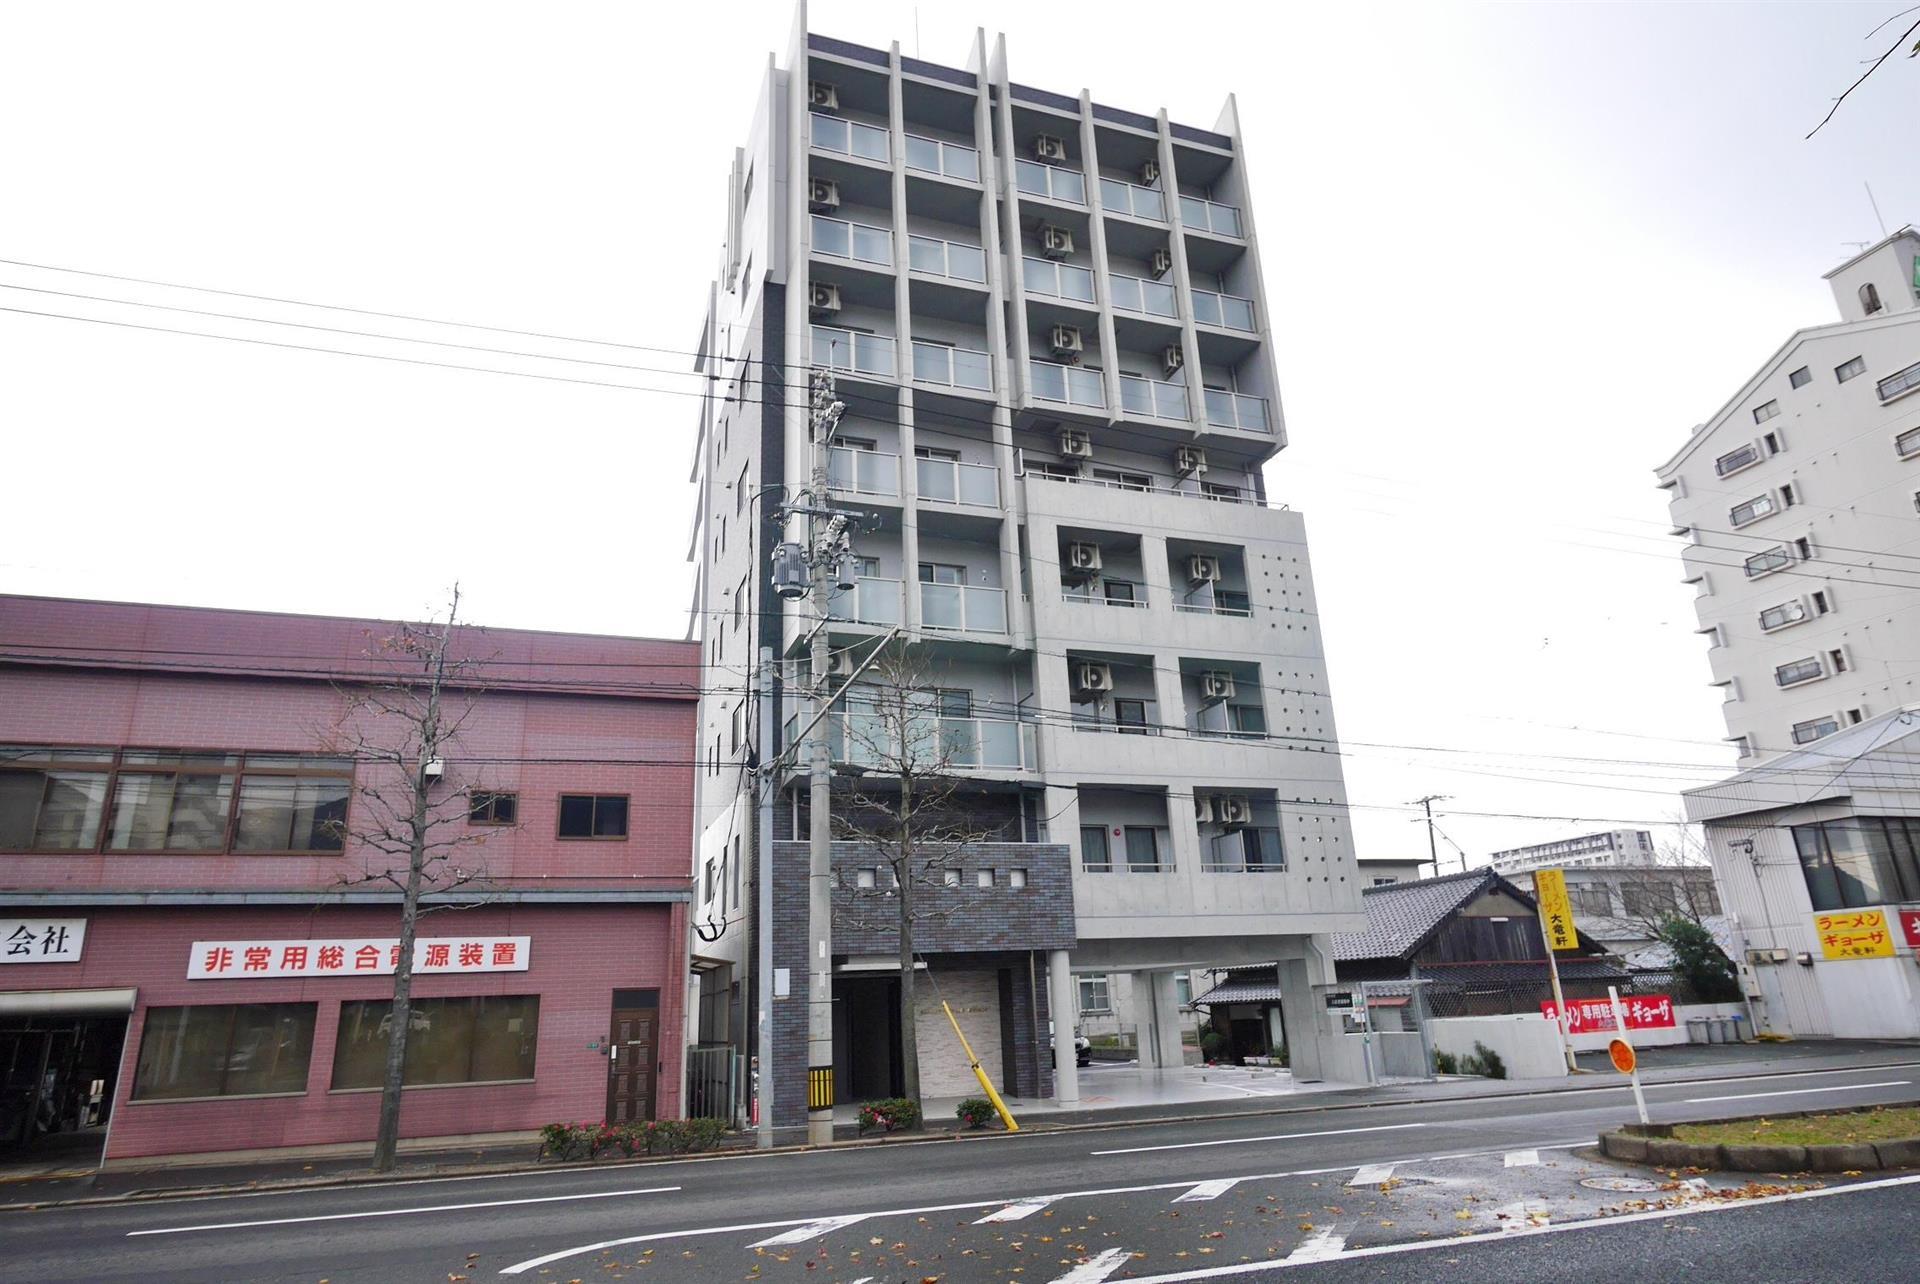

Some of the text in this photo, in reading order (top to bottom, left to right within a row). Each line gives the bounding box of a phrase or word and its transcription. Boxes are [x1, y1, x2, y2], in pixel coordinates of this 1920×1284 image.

[1548, 871, 1563, 912] ラーメン
[1819, 913, 1880, 930] ラーメン
[0, 925, 70, 955] 会社
[1823, 930, 1883, 947] ギョーザ
[1546, 1006, 1580, 1027] ラメン
[1632, 1000, 1669, 1022] ギョーザ
